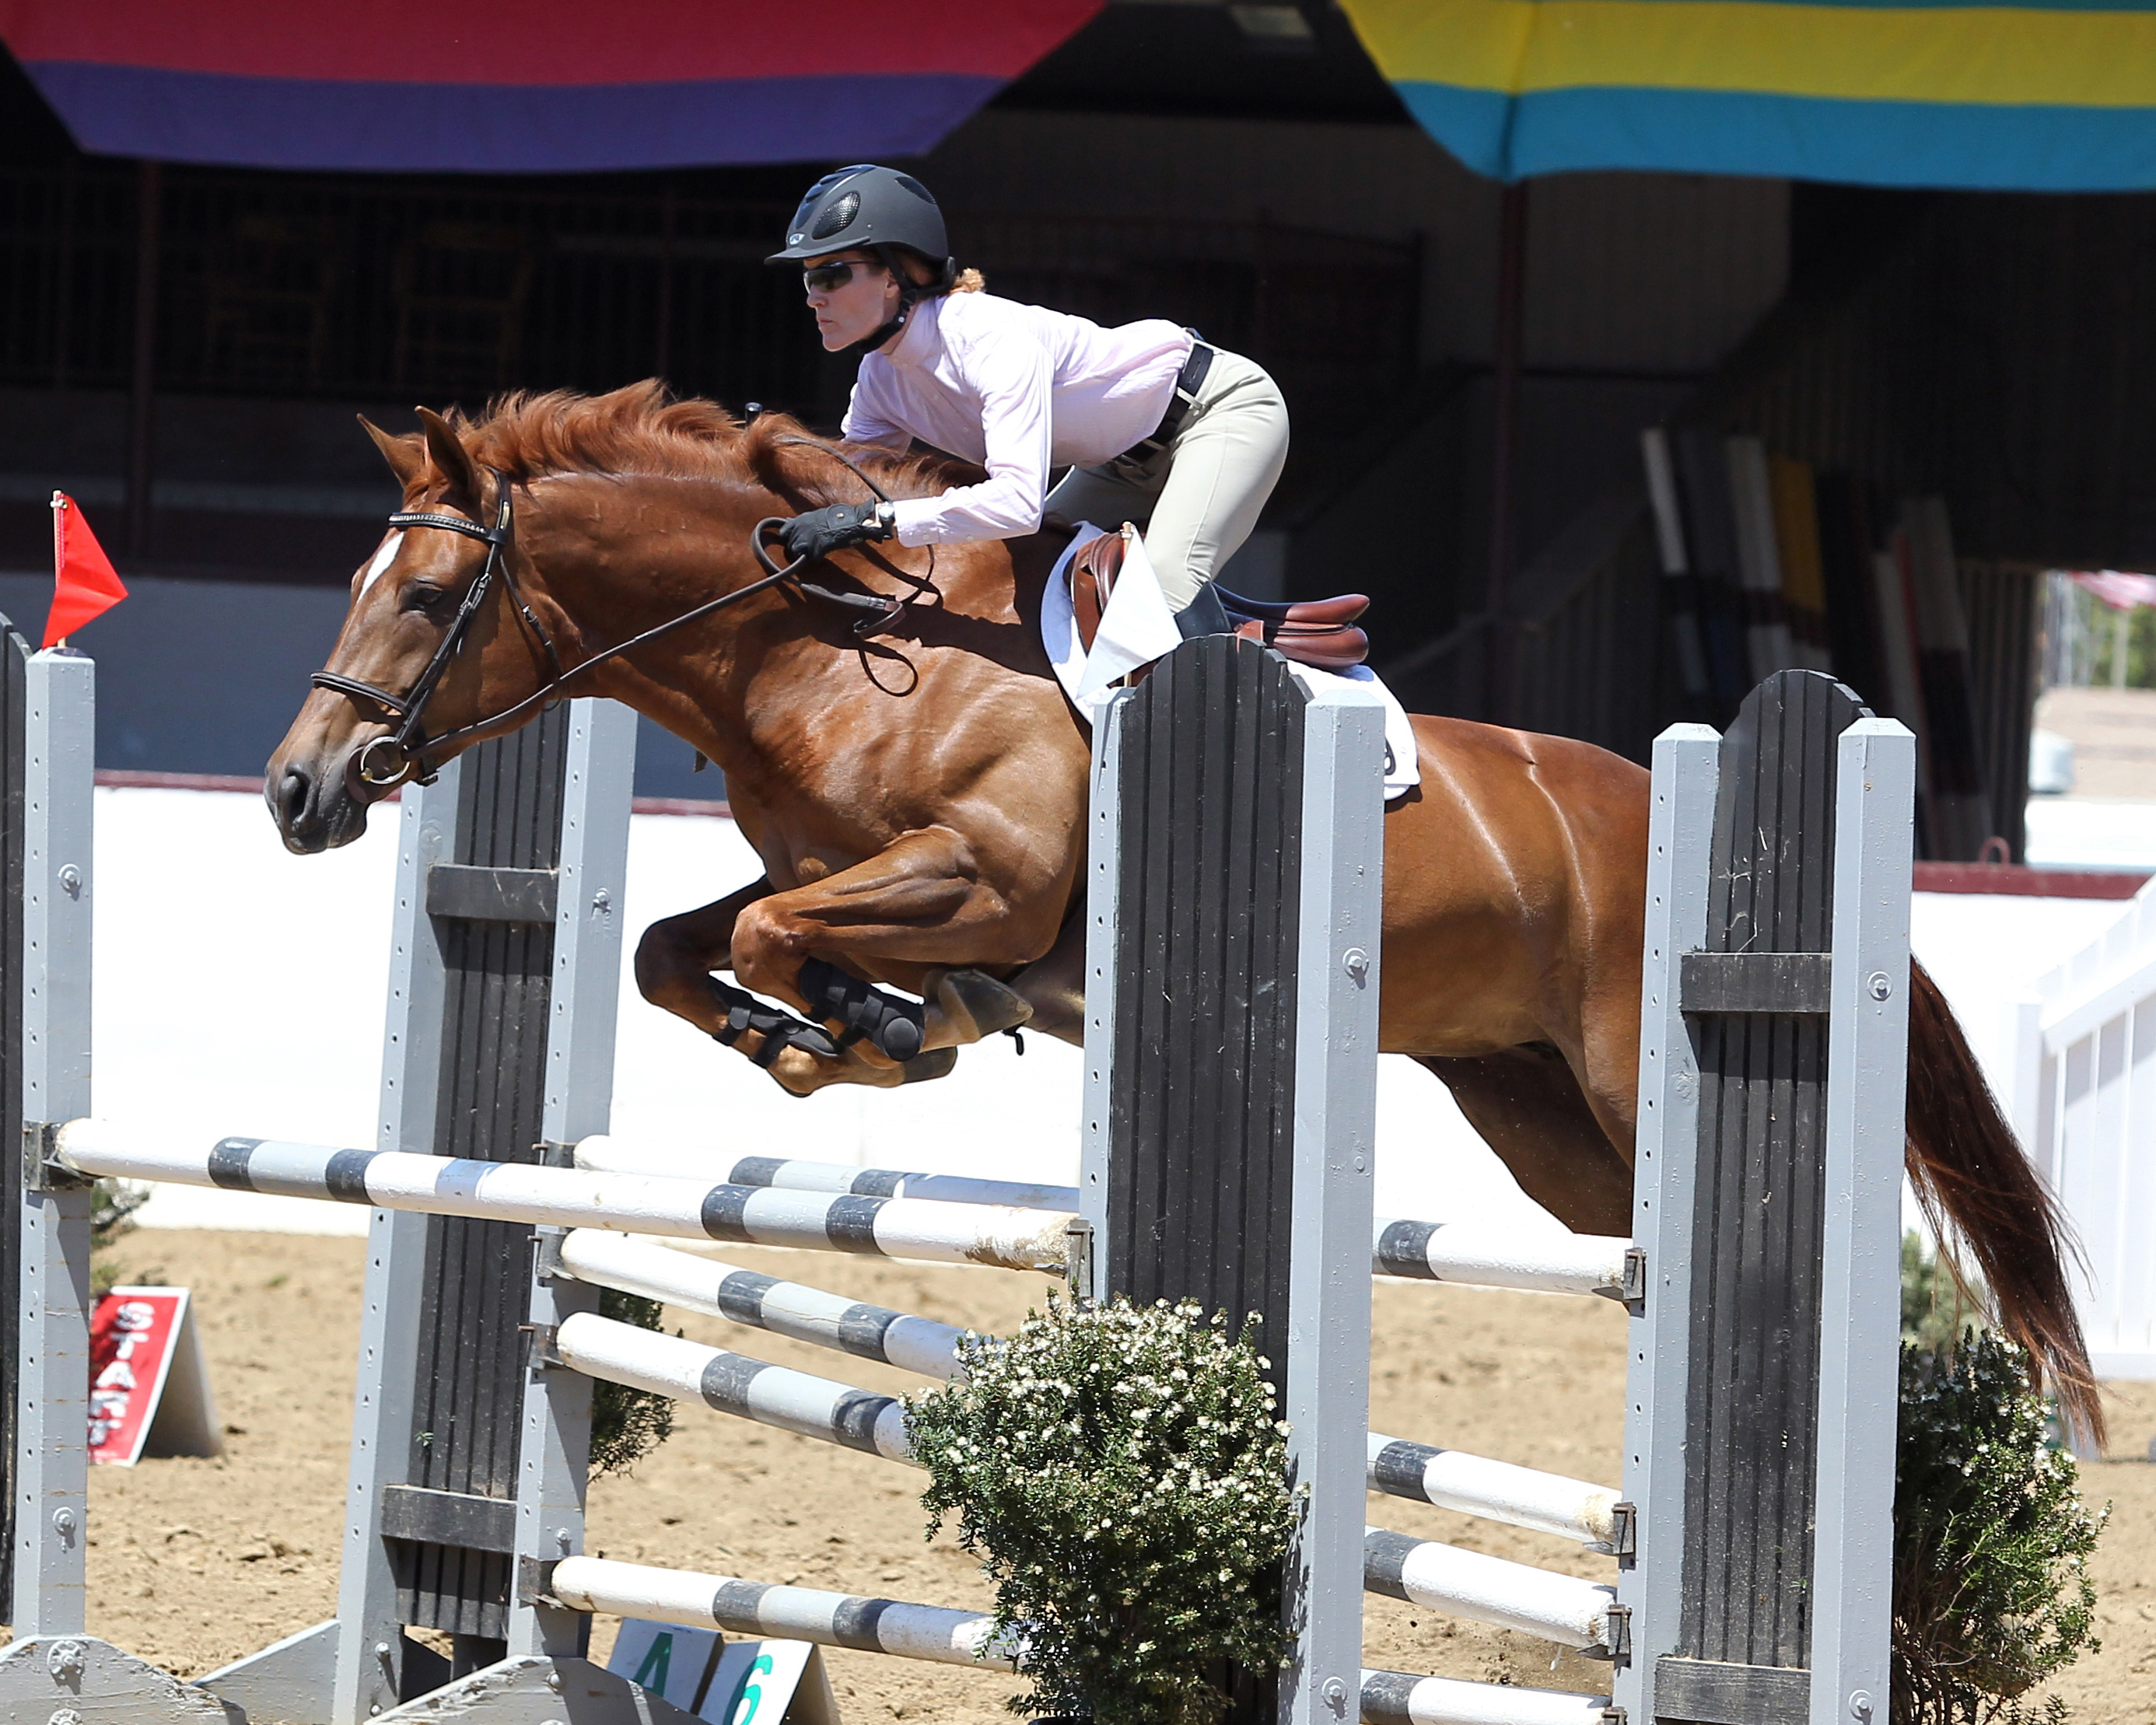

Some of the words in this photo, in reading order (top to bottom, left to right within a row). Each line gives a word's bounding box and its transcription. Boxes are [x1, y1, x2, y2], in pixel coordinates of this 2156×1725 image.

[89, 1302, 155, 1445] START
[634, 1632, 673, 1696] A
[723, 1654, 773, 1725] 6
